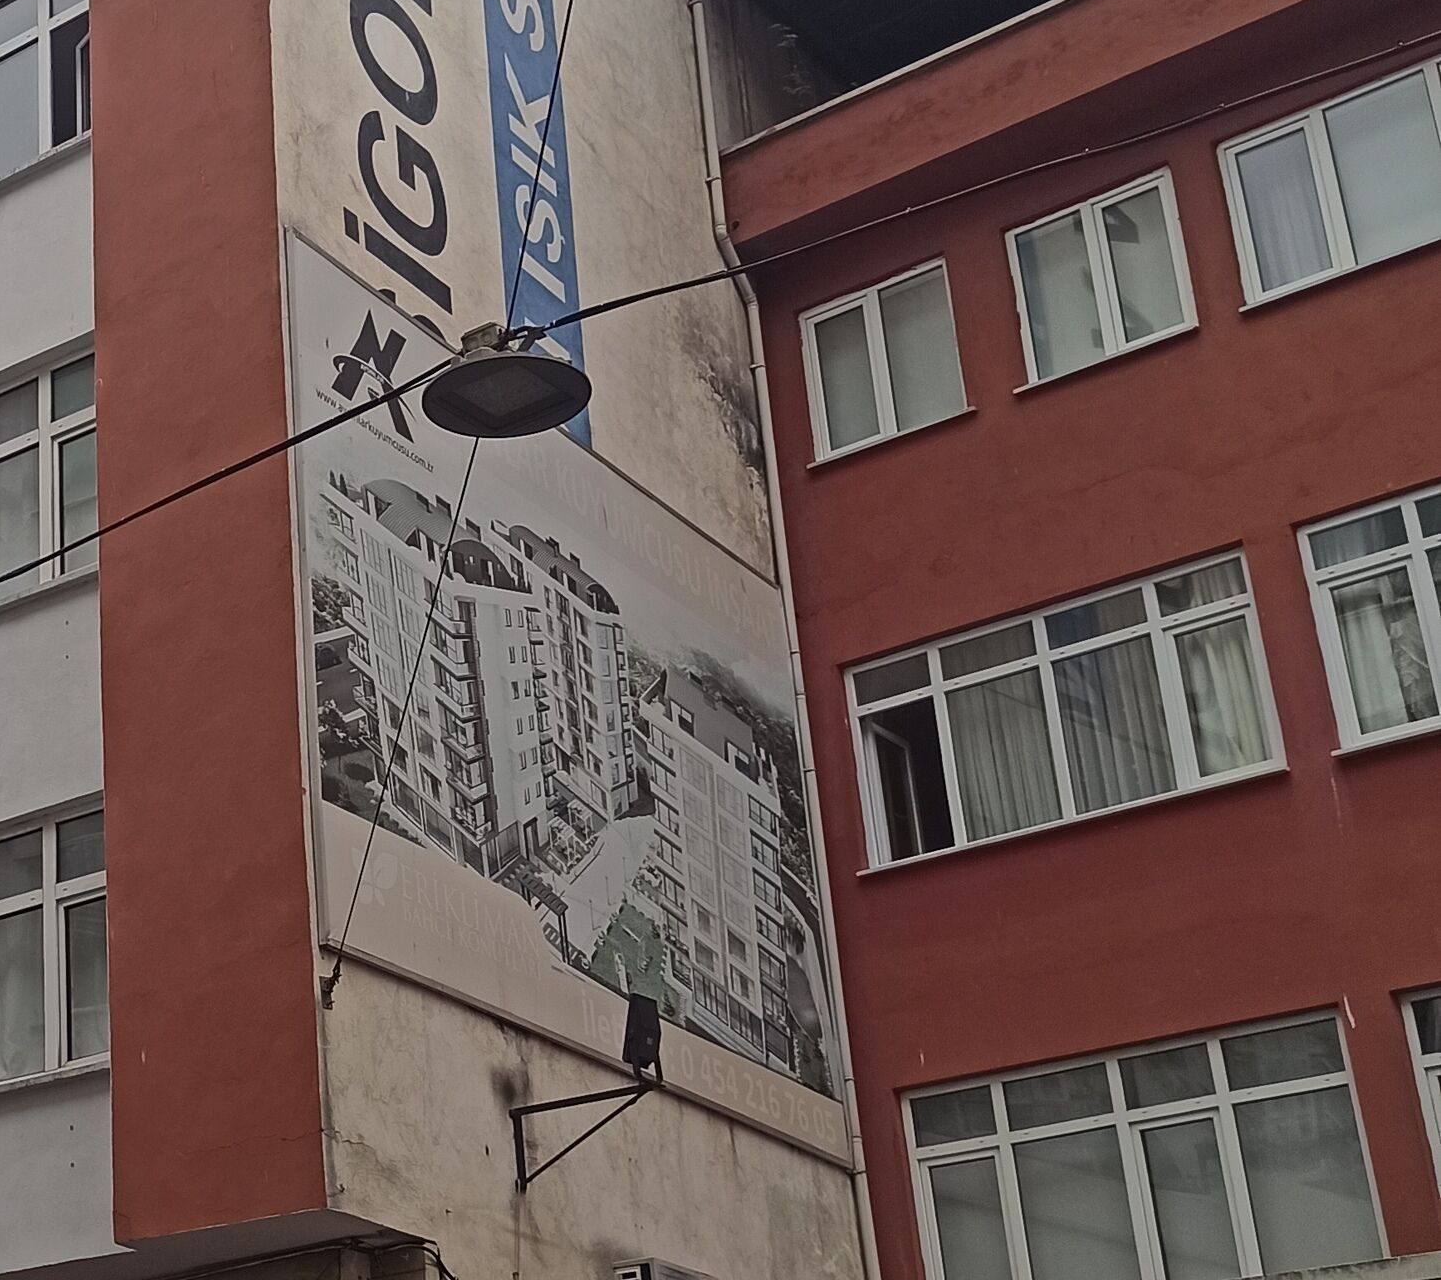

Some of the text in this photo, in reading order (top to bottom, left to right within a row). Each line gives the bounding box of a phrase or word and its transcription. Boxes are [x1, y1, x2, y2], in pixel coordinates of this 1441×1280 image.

[489, 53, 567, 303] IŞIK
[700, 1054, 739, 1100] 454
[743, 1070, 781, 1119] 216
[784, 1090, 809, 1131] 76
